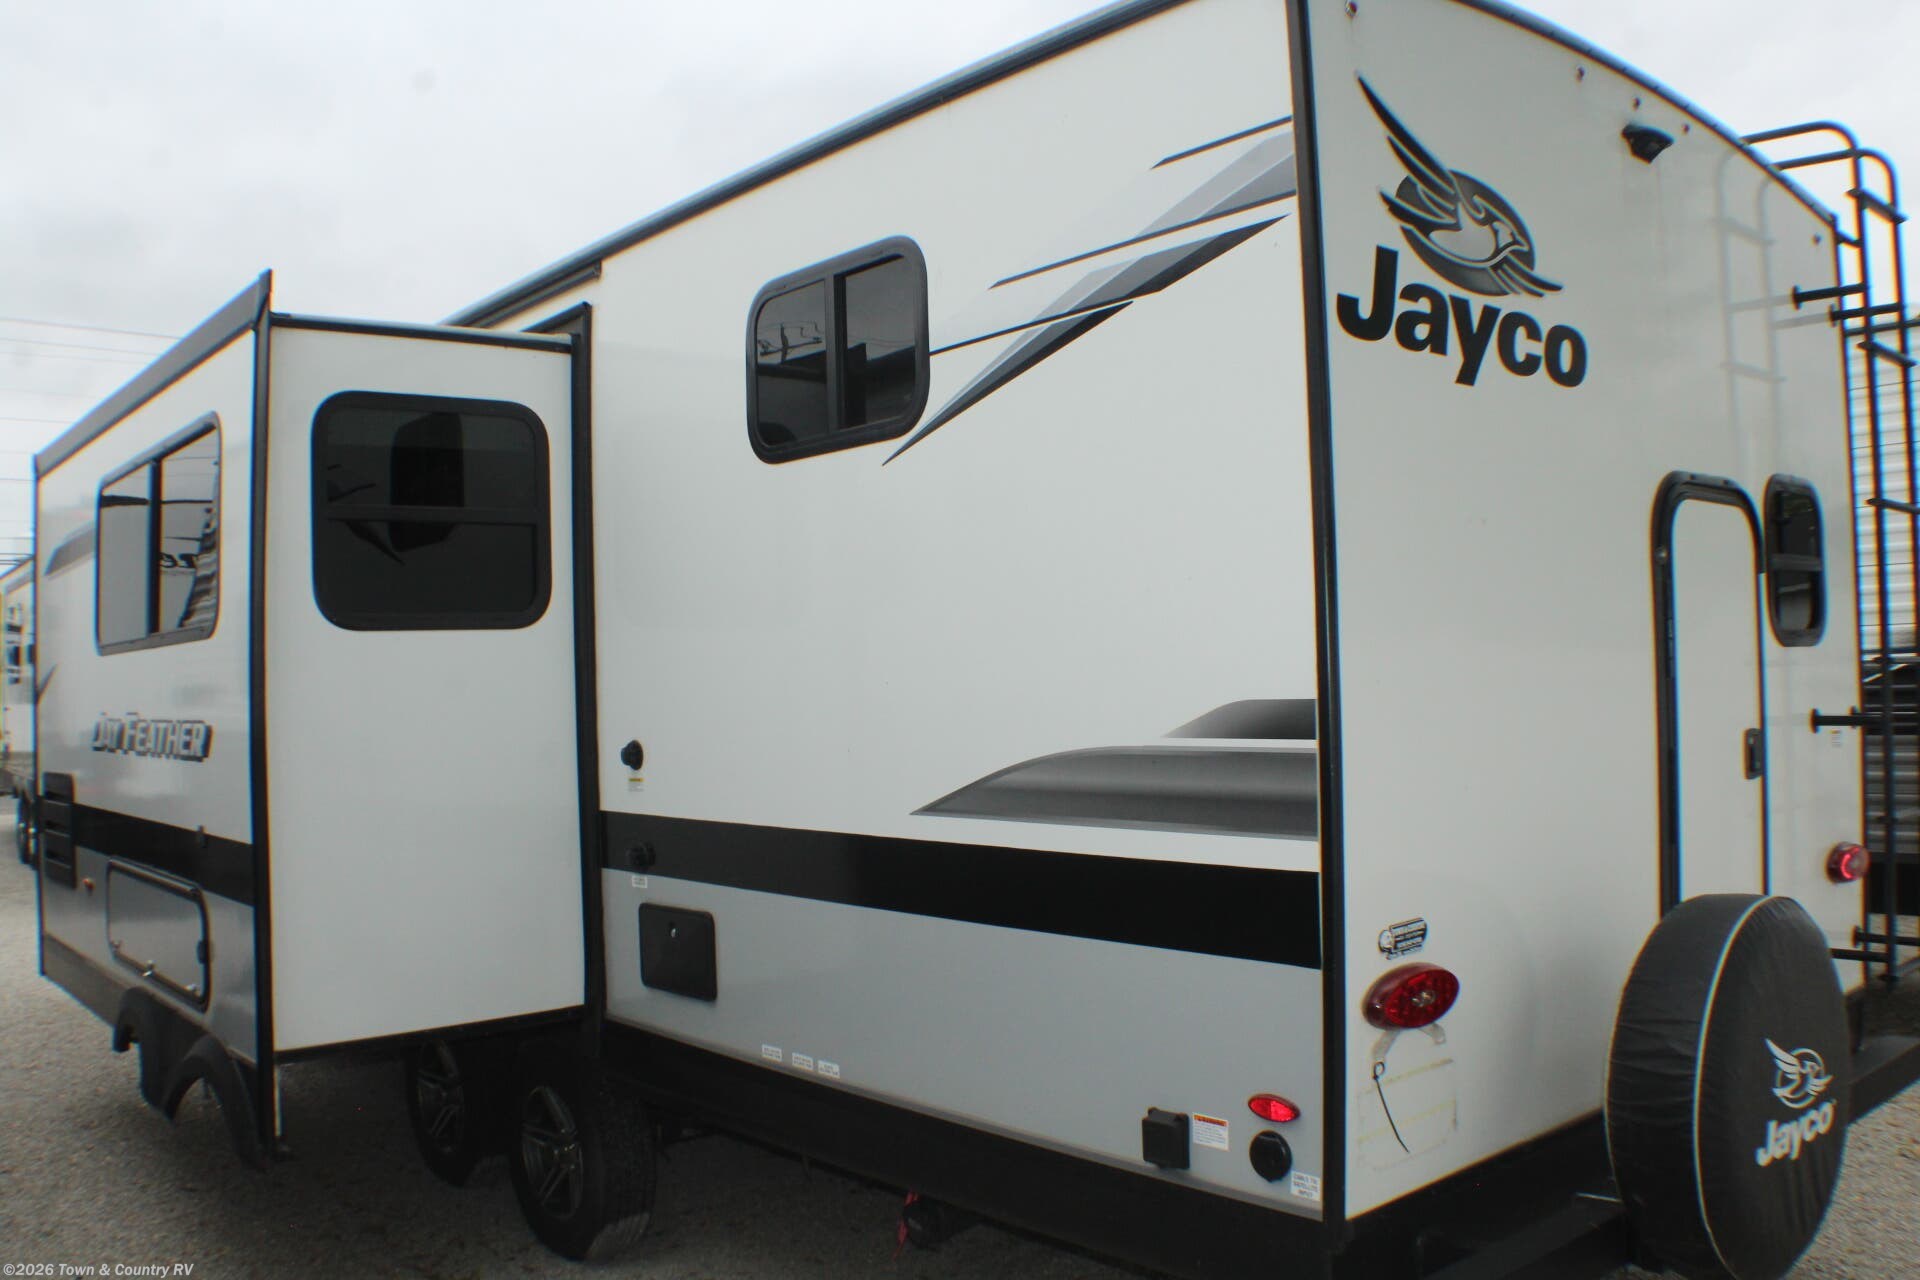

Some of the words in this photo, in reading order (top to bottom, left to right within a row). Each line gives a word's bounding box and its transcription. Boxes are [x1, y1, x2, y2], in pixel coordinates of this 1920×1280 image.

[1337, 245, 1587, 387] Jayco
[123, 712, 213, 762] FEATHER
[1755, 1101, 1835, 1166] Jayco
